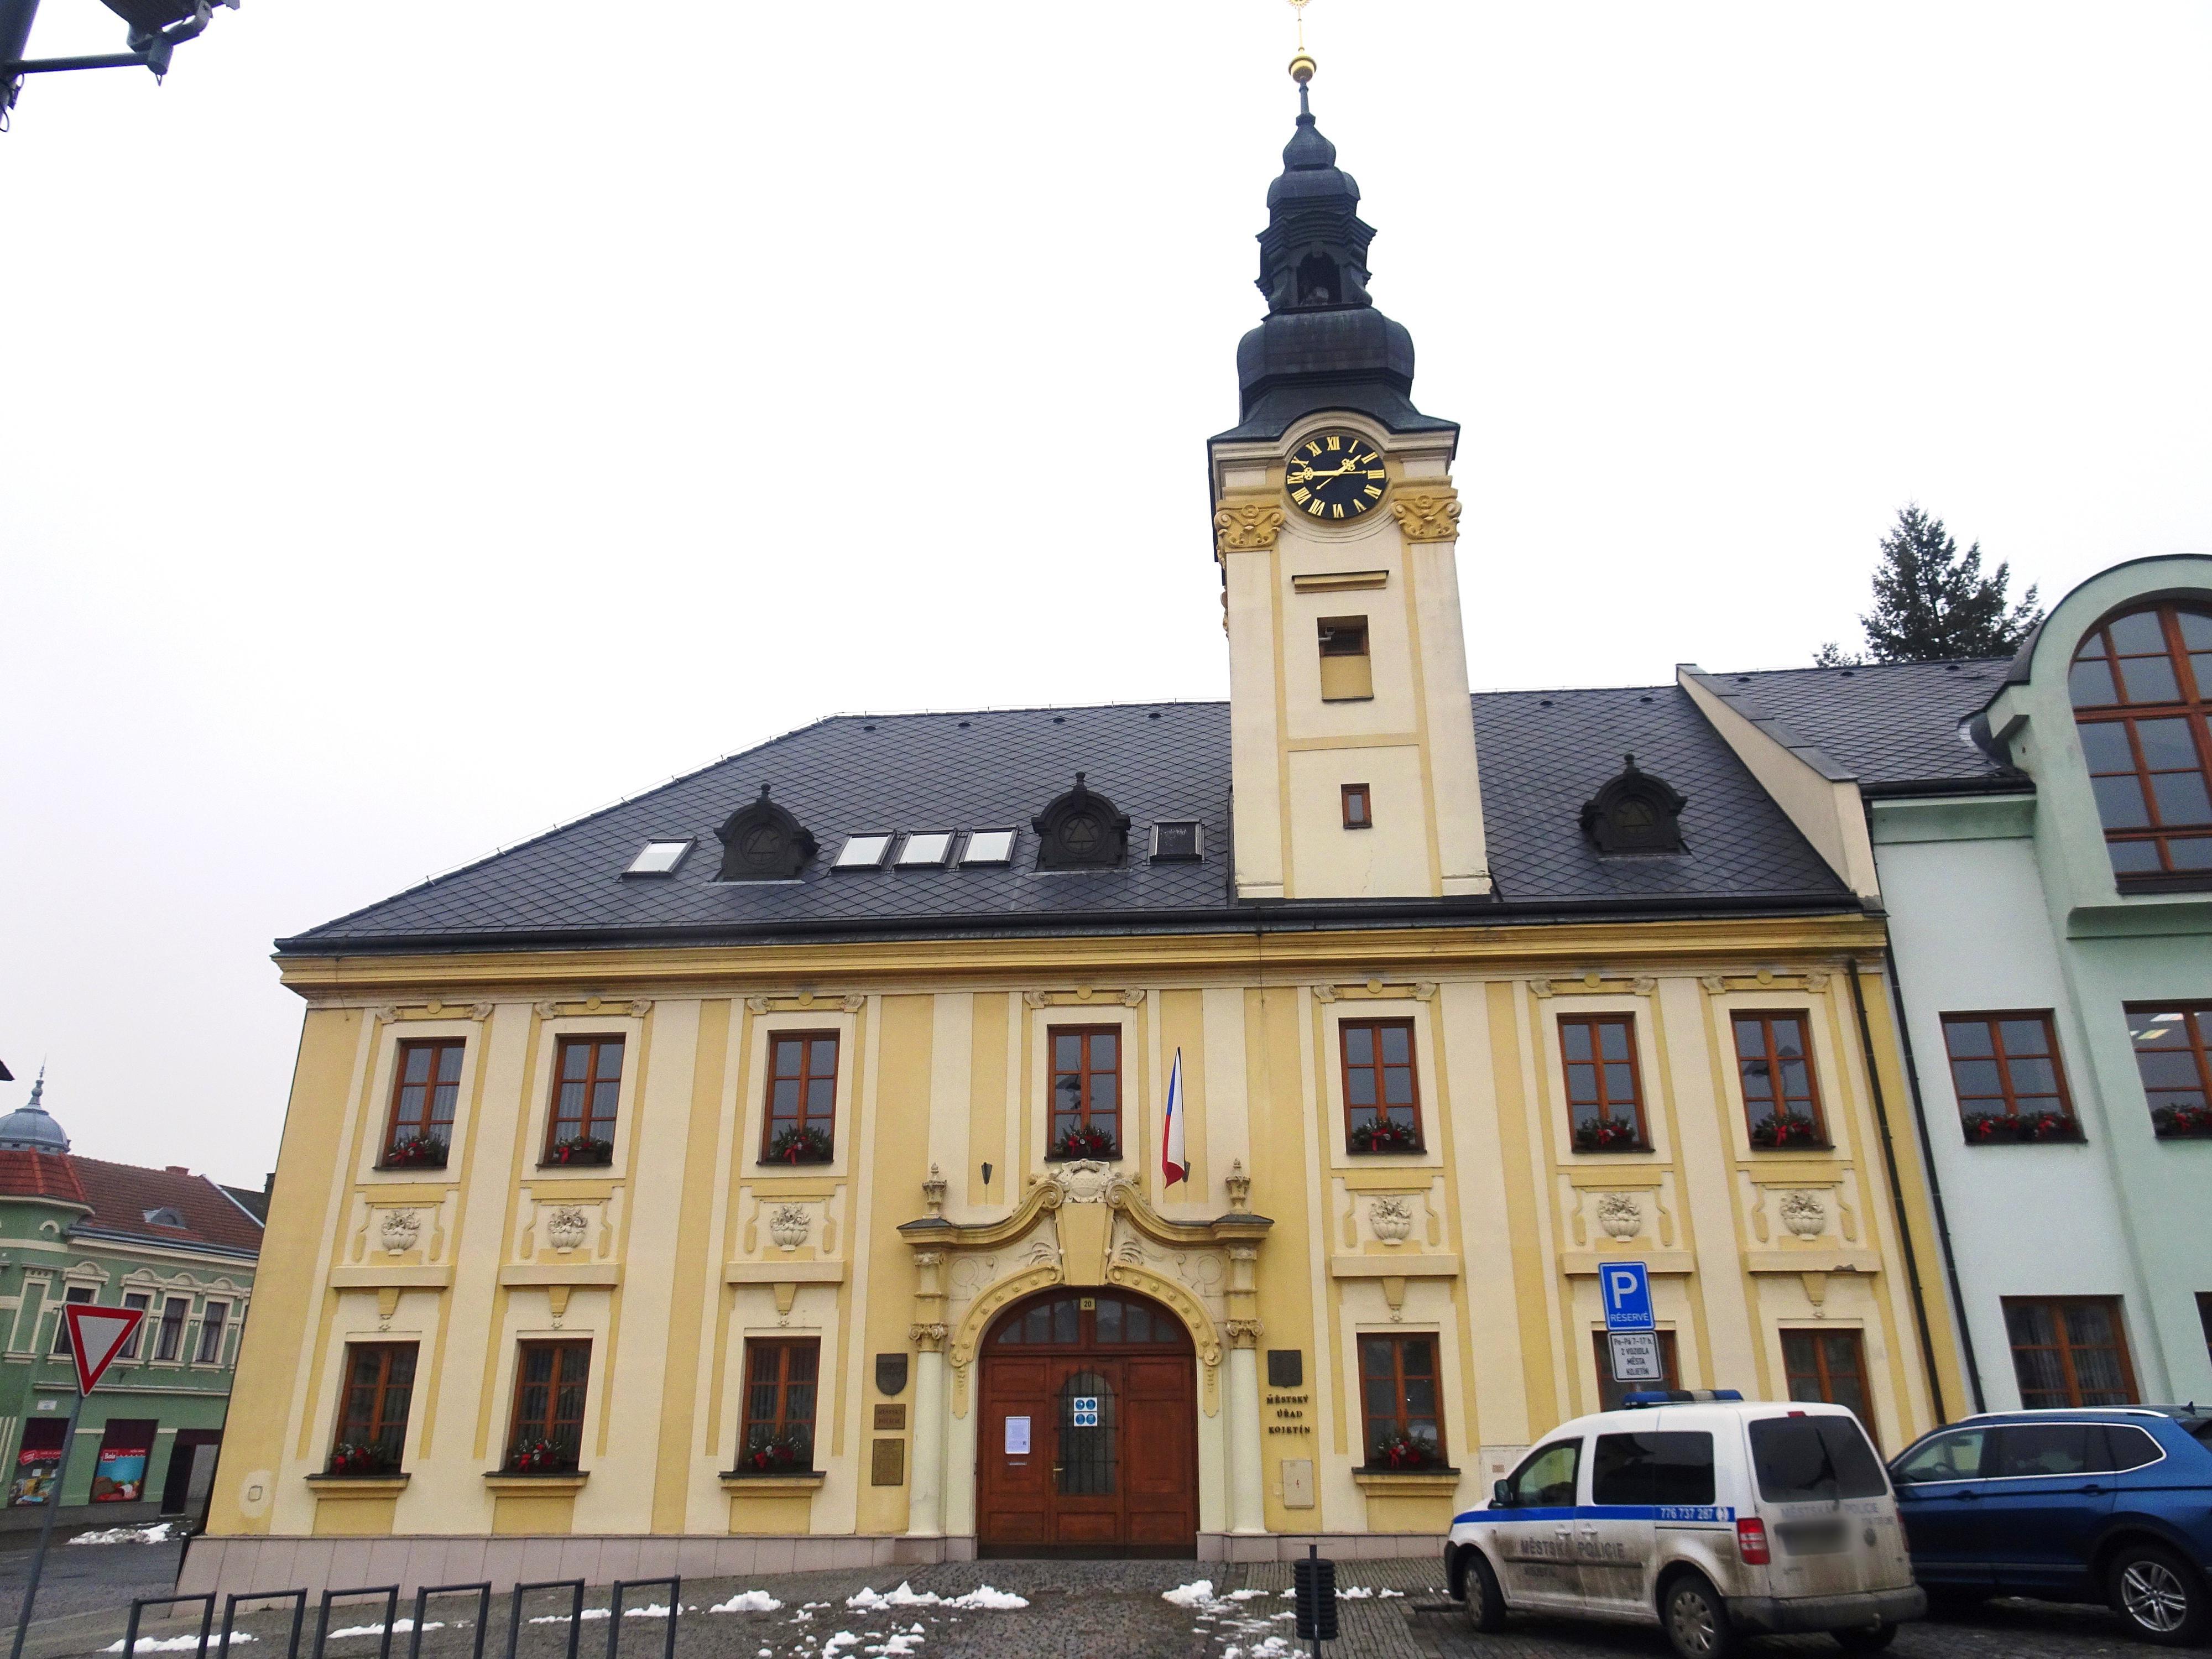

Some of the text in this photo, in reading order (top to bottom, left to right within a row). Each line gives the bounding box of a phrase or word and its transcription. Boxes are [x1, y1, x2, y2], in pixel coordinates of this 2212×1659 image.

[1305, 441, 1322, 457] XI
[1327, 436, 1340, 451] XII
[1291, 456, 1309, 468] X
[1361, 452, 1379, 464] II
[1287, 474, 1304, 484] IX
[1368, 469, 1385, 479] III
[1291, 486, 1312, 505] VIII
[1363, 484, 1382, 499] IV
[1308, 498, 1326, 517] VII
[1332, 503, 1344, 518] VI
[1353, 499, 1367, 513] V
[1610, 1271, 1637, 1308] P
[1266, 1394, 1308, 1404] MĚSTSKÝ
[1277, 1408, 1302, 1417] ÚŘAD
